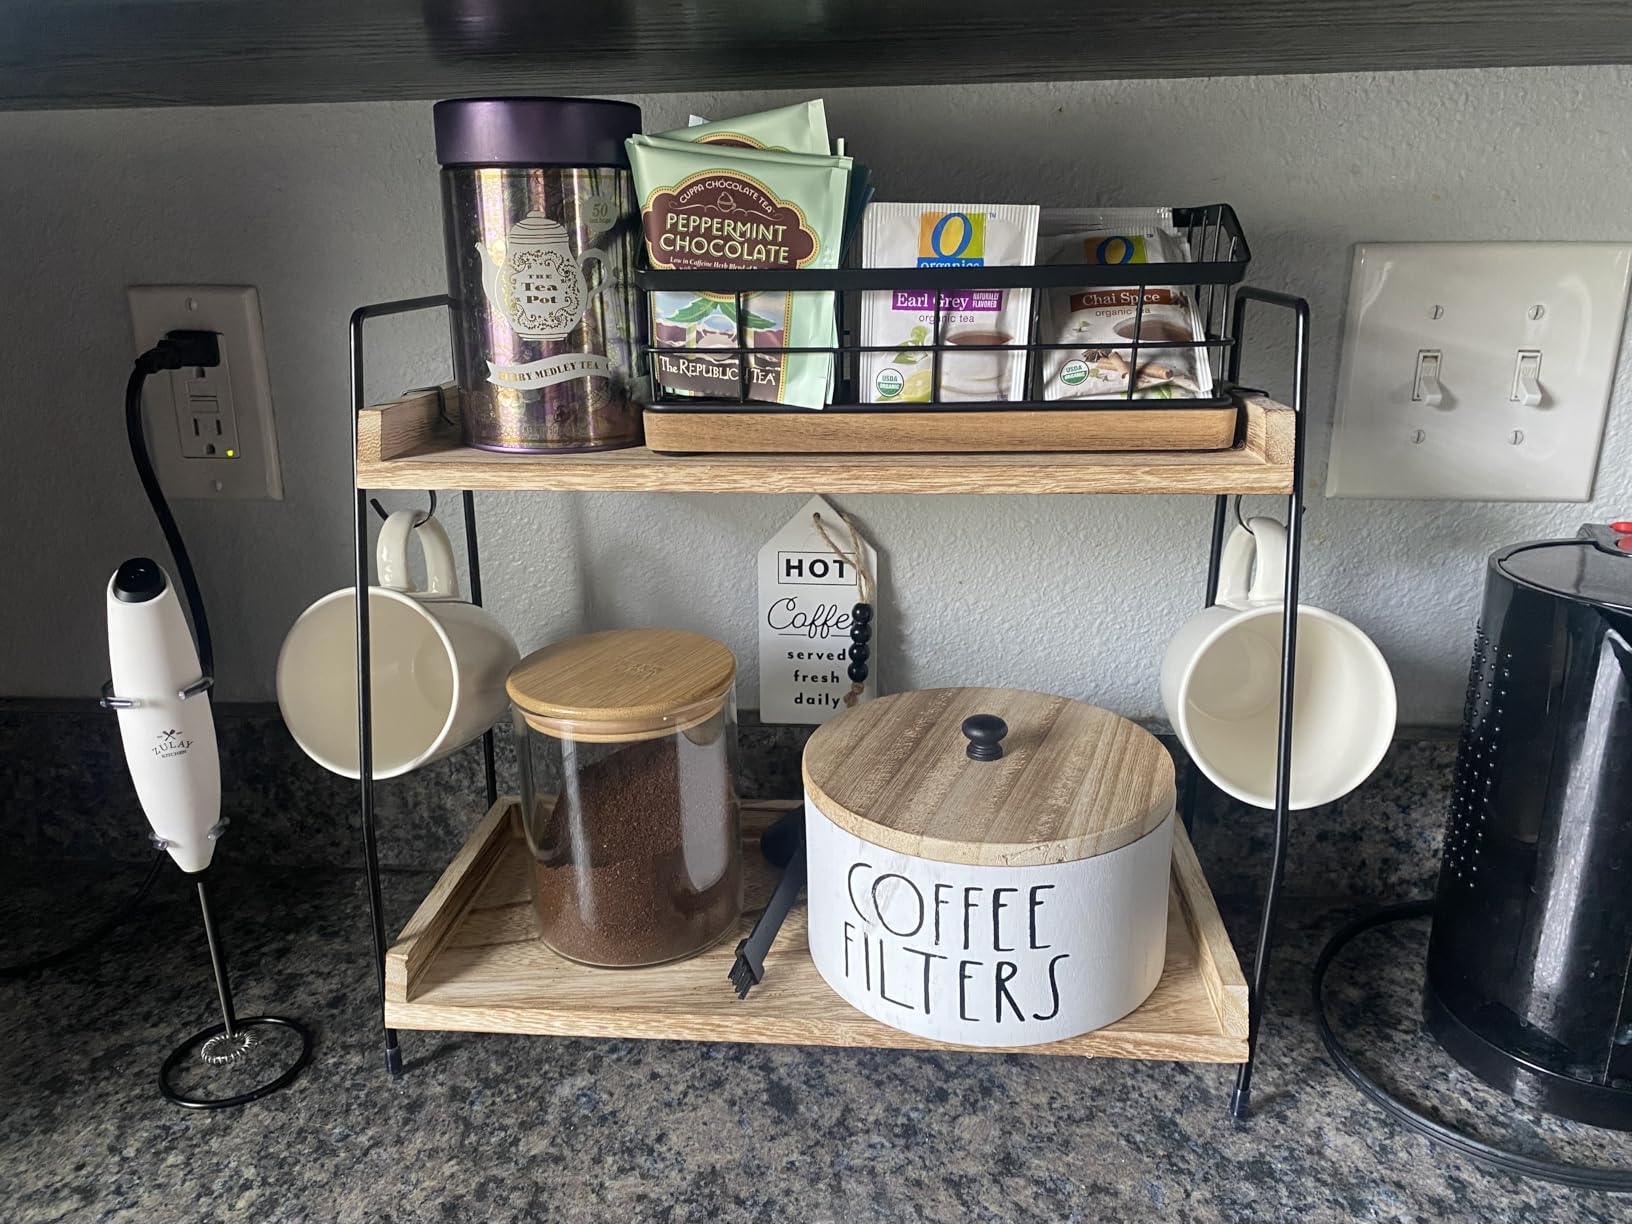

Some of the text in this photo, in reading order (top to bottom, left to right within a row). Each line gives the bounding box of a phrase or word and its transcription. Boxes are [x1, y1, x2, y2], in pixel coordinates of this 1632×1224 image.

[680, 180, 773, 213] CUPPA CHOCOLATE TEA
[592, 202, 608, 217] 50
[665, 213, 787, 242] PEPPERMINT
[659, 233, 789, 264] CHOCOLATE
[670, 256, 681, 264] Low
[689, 259, 712, 268] Caffeine
[713, 261, 728, 269] Herb
[521, 282, 558, 291] Tea
[526, 295, 558, 304] Pot
[896, 292, 929, 308] Earl
[972, 300, 997, 308] FLAVORED
[1082, 292, 1160, 306] Chai Spce
[918, 313, 975, 325] orgnic tea
[1095, 308, 1133, 317] organic
[535, 362, 577, 379] MEDLEY
[580, 361, 599, 370] TEA
[659, 355, 678, 374] The
[679, 359, 740, 381] REPUBLIC
[750, 368, 776, 386] TEA
[785, 558, 847, 578] HOT
[767, 596, 855, 639] Coffe
[787, 648, 846, 661] served
[793, 670, 840, 683] fresh
[793, 692, 840, 709] daily
[152, 741, 193, 755] ZULAY
[847, 862, 1056, 952] COFFEE
[844, 920, 1070, 1024] FILTERS
